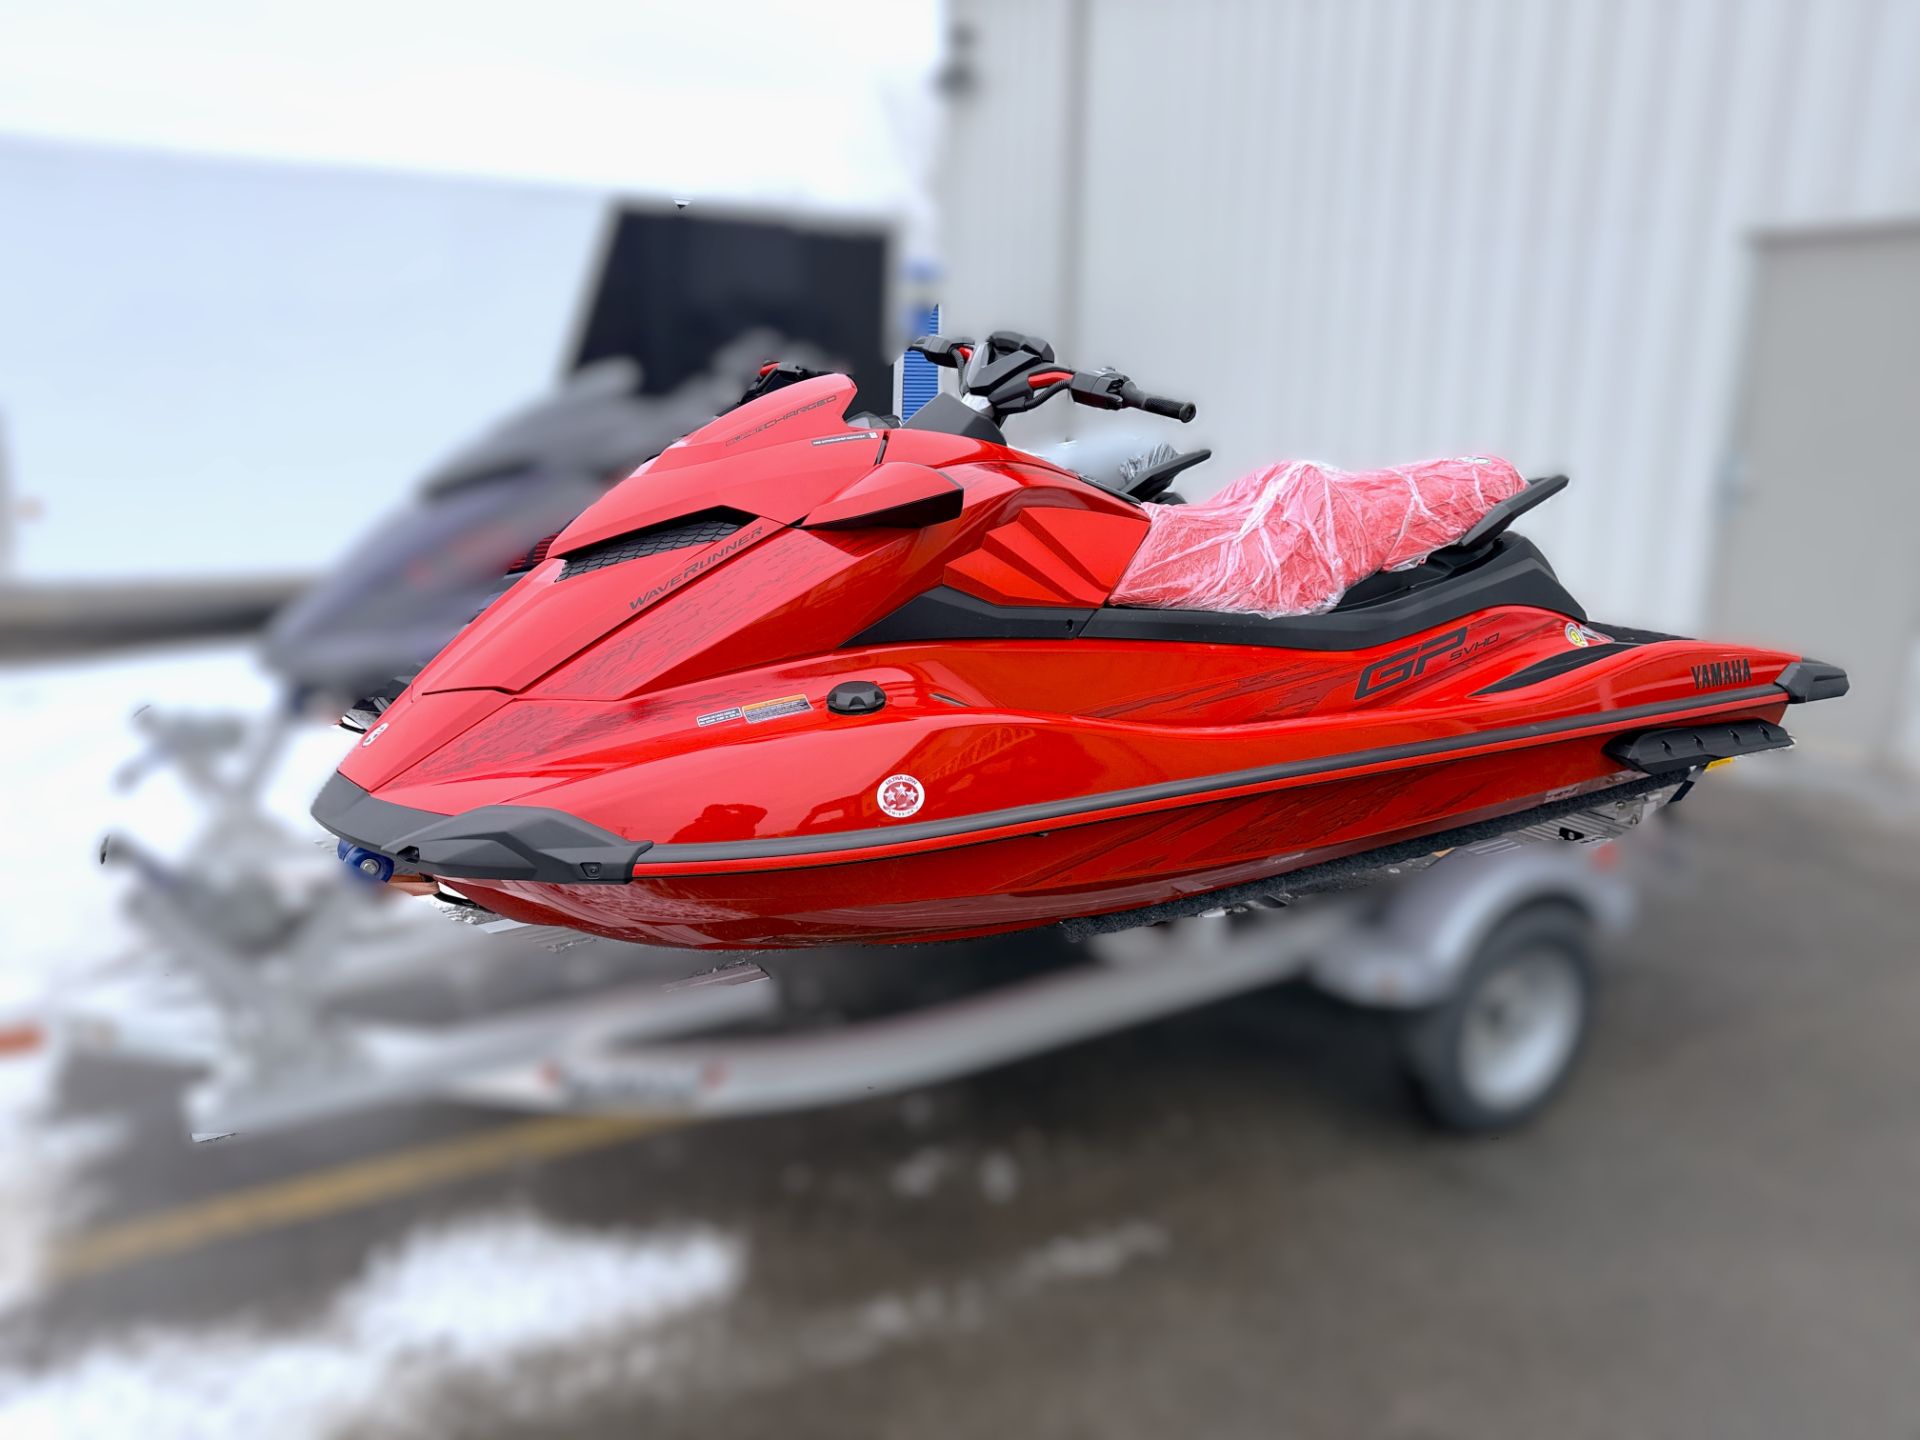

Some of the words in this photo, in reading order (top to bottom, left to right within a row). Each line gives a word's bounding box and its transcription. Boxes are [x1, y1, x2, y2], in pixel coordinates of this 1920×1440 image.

[725, 395, 837, 447] CHARGED
[1354, 626, 1467, 700] GP
[1449, 632, 1499, 662] SVHO
[1690, 658, 1752, 690] YAMAHA
[885, 775, 903, 786] ULTRA
[904, 776, 917, 785] LOW
